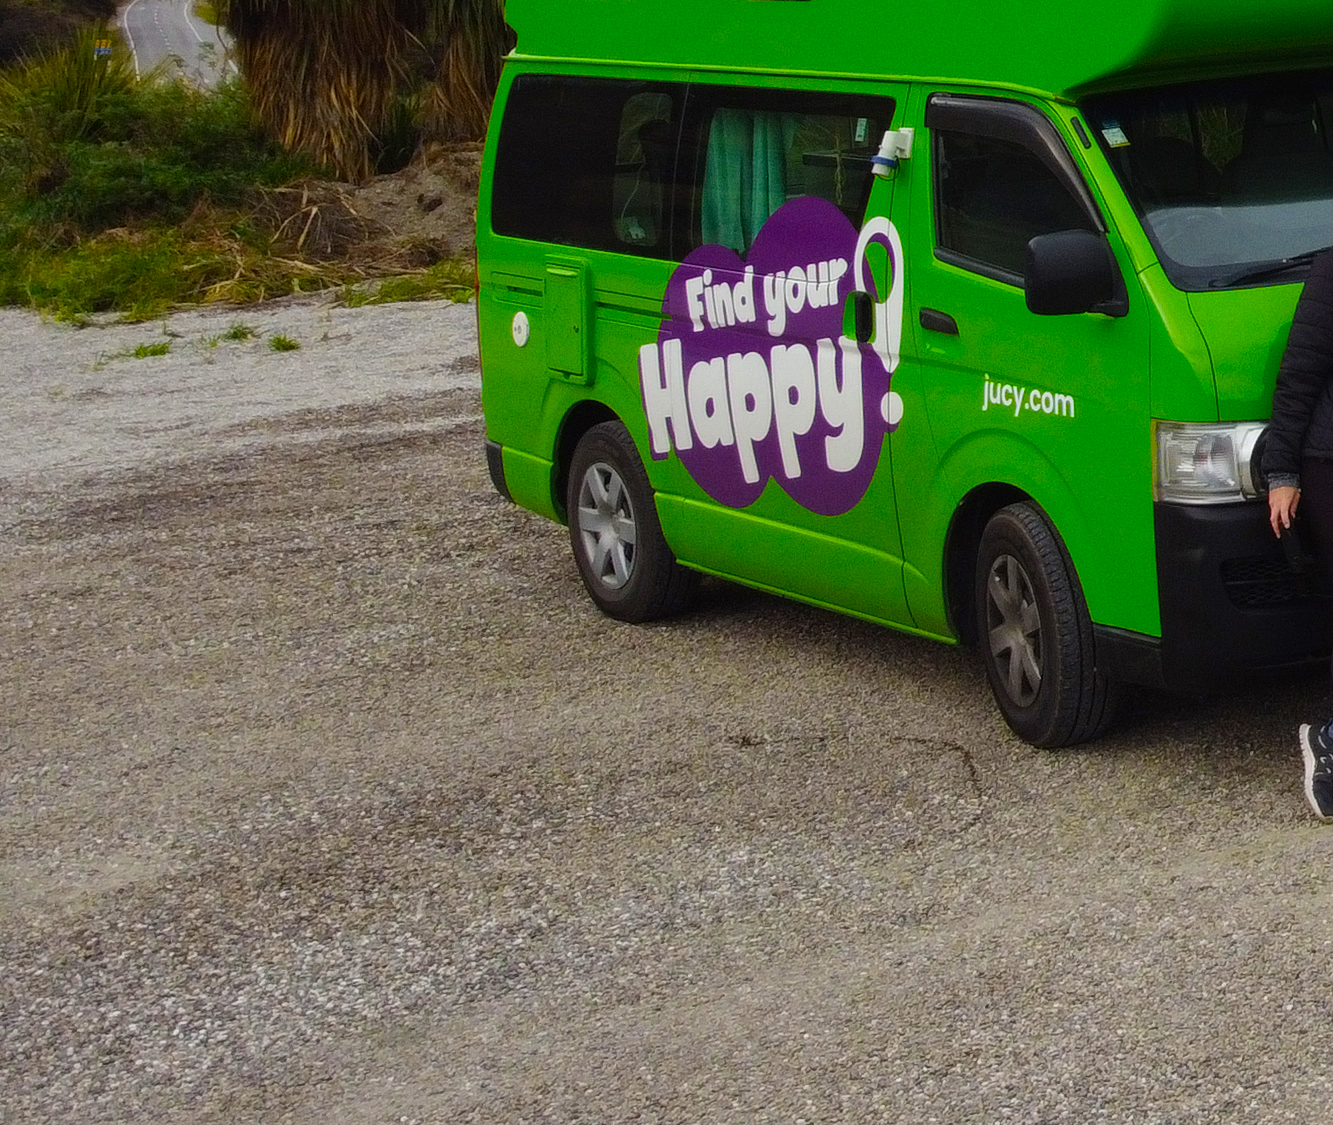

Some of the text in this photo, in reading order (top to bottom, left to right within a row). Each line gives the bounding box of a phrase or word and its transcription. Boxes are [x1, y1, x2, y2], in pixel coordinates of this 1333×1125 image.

[685, 258, 848, 337] Find your
[981, 373, 1075, 418] jucy.com
